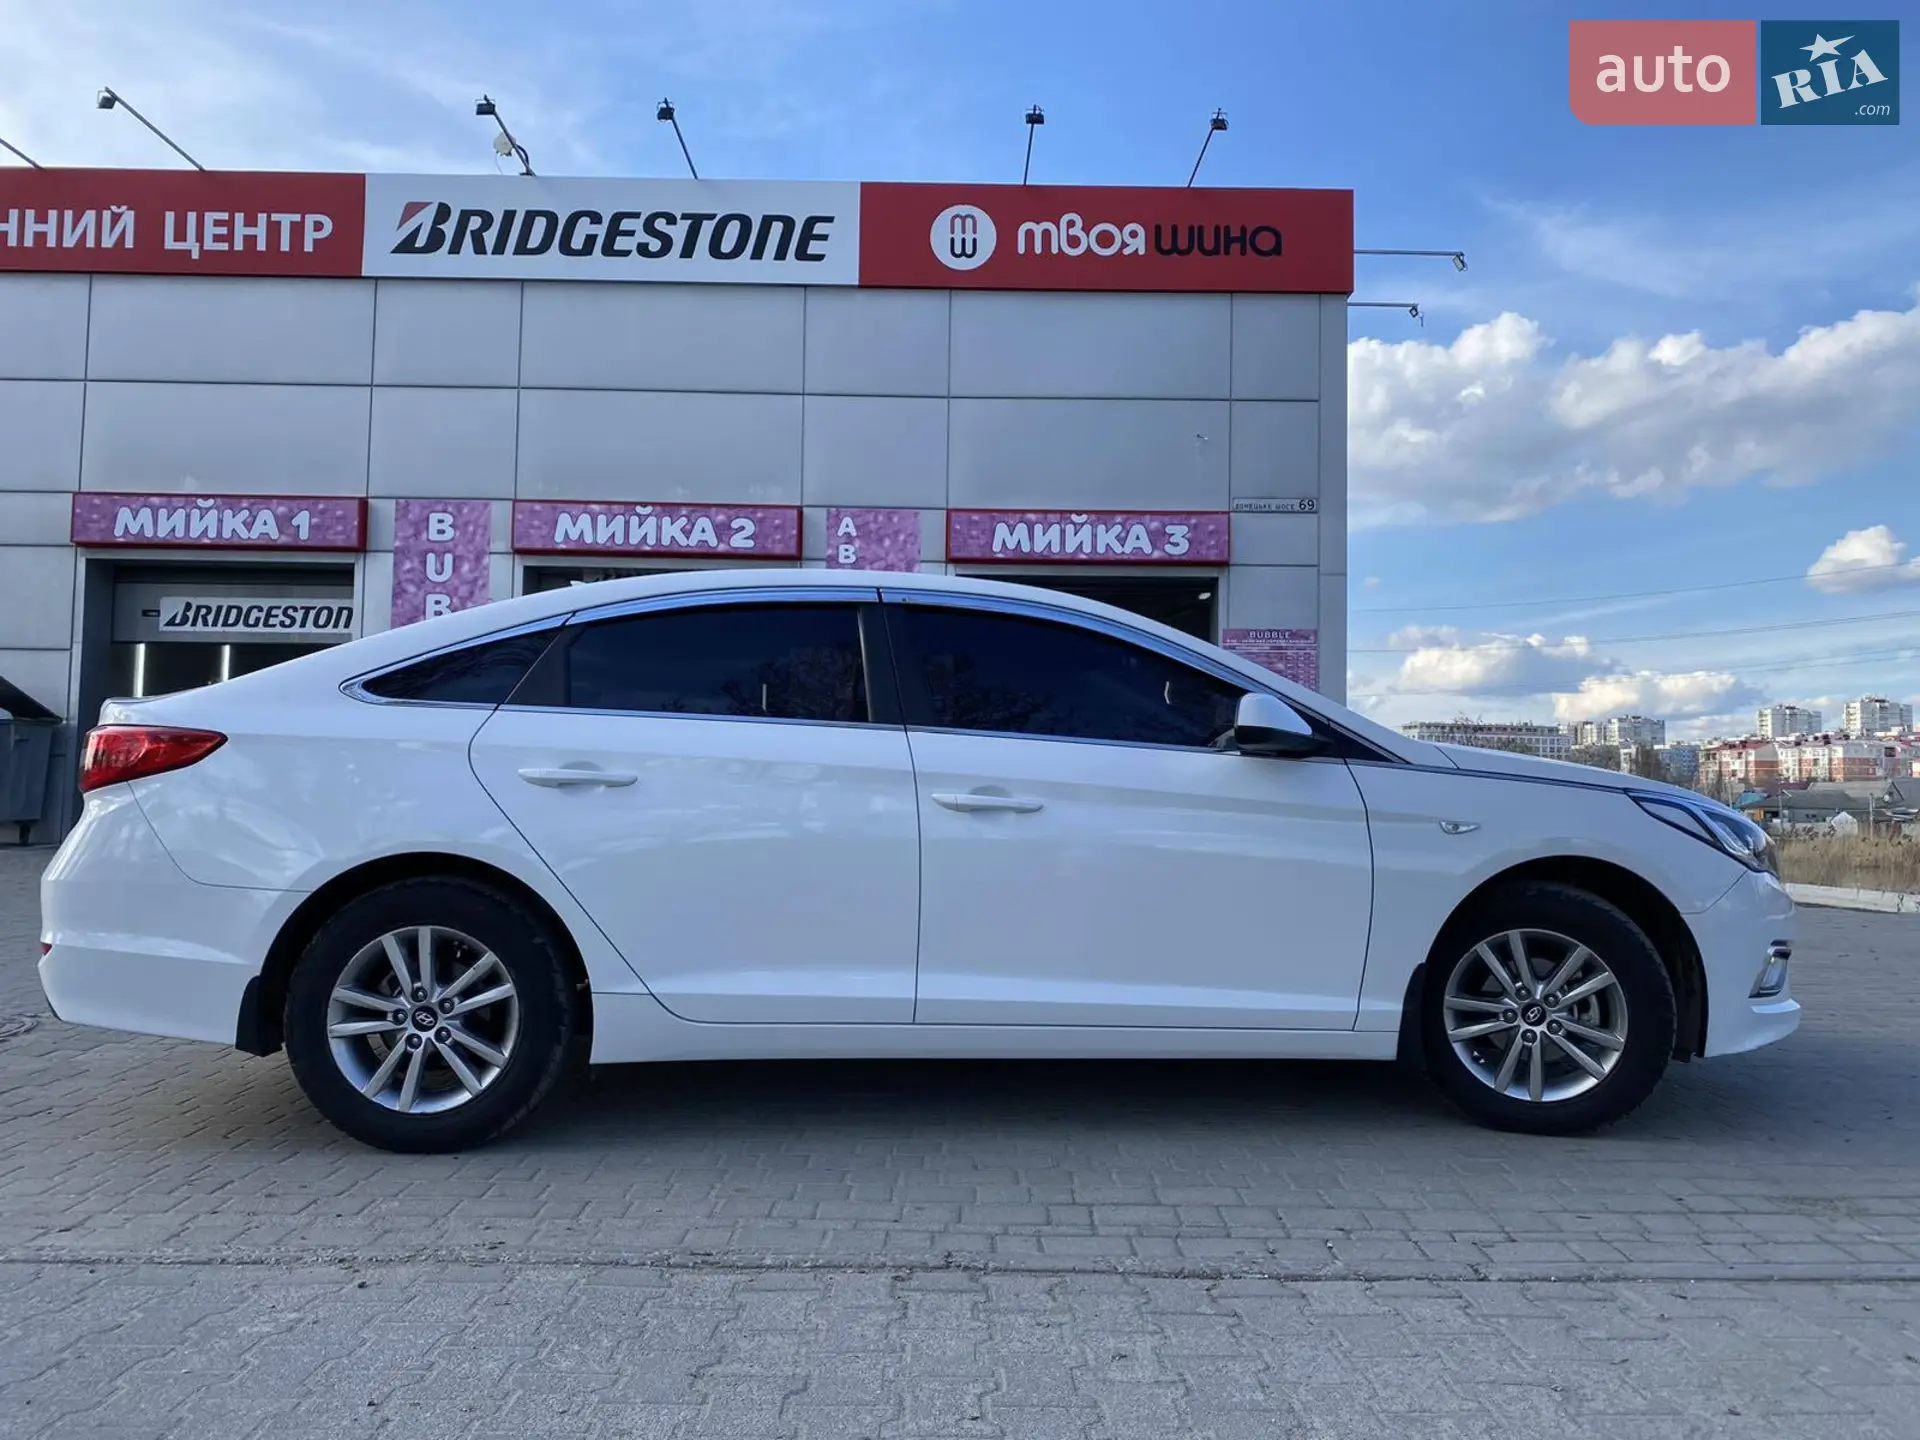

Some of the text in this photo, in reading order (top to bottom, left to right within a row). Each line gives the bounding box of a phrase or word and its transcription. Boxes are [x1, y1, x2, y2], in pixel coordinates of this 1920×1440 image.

[164, 210, 334, 260] ЦЕНТР
[390, 201, 835, 262] BRIDGESTONE
[1154, 223, 1283, 257] шина
[113, 498, 311, 541] МИЙКА 1
[1299, 498, 1315, 511] 69
[553, 504, 757, 549] МИЙКА 2
[992, 513, 1191, 556] МИЙКА 3
